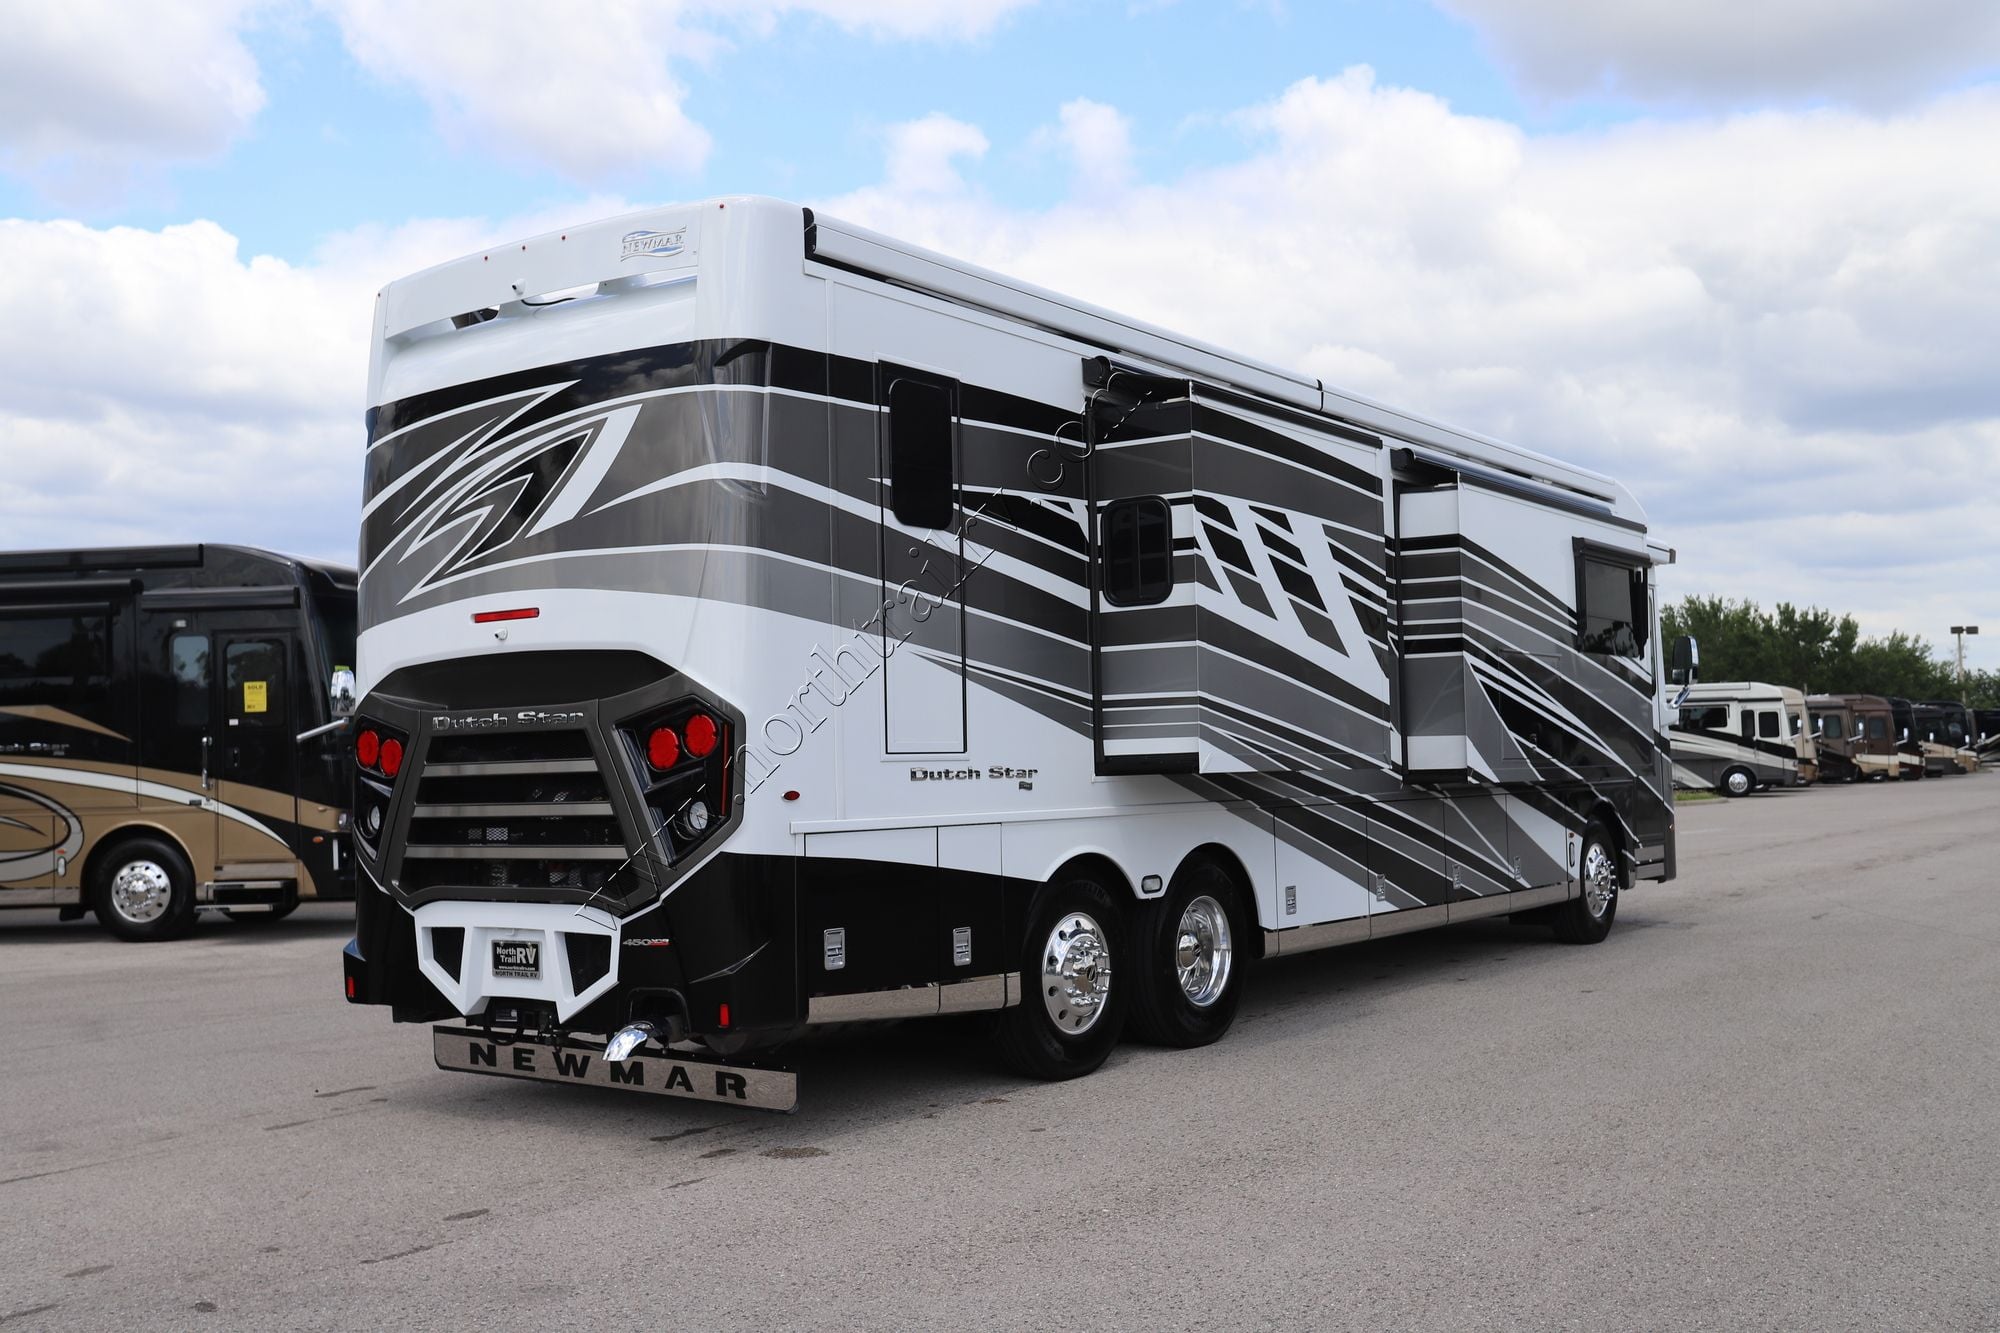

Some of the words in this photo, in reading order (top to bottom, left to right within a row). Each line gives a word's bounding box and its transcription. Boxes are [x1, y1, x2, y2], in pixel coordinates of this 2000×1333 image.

[622, 234, 684, 254] NEWMAR
[432, 712, 508, 731] Dutch
[517, 710, 584, 725] Star
[910, 766, 981, 782] Dutch
[988, 765, 1039, 780] Star
[496, 946, 516, 955] North
[517, 947, 537, 964] RV
[500, 955, 516, 963] Trail
[469, 1042, 748, 1100] NEWMAR
